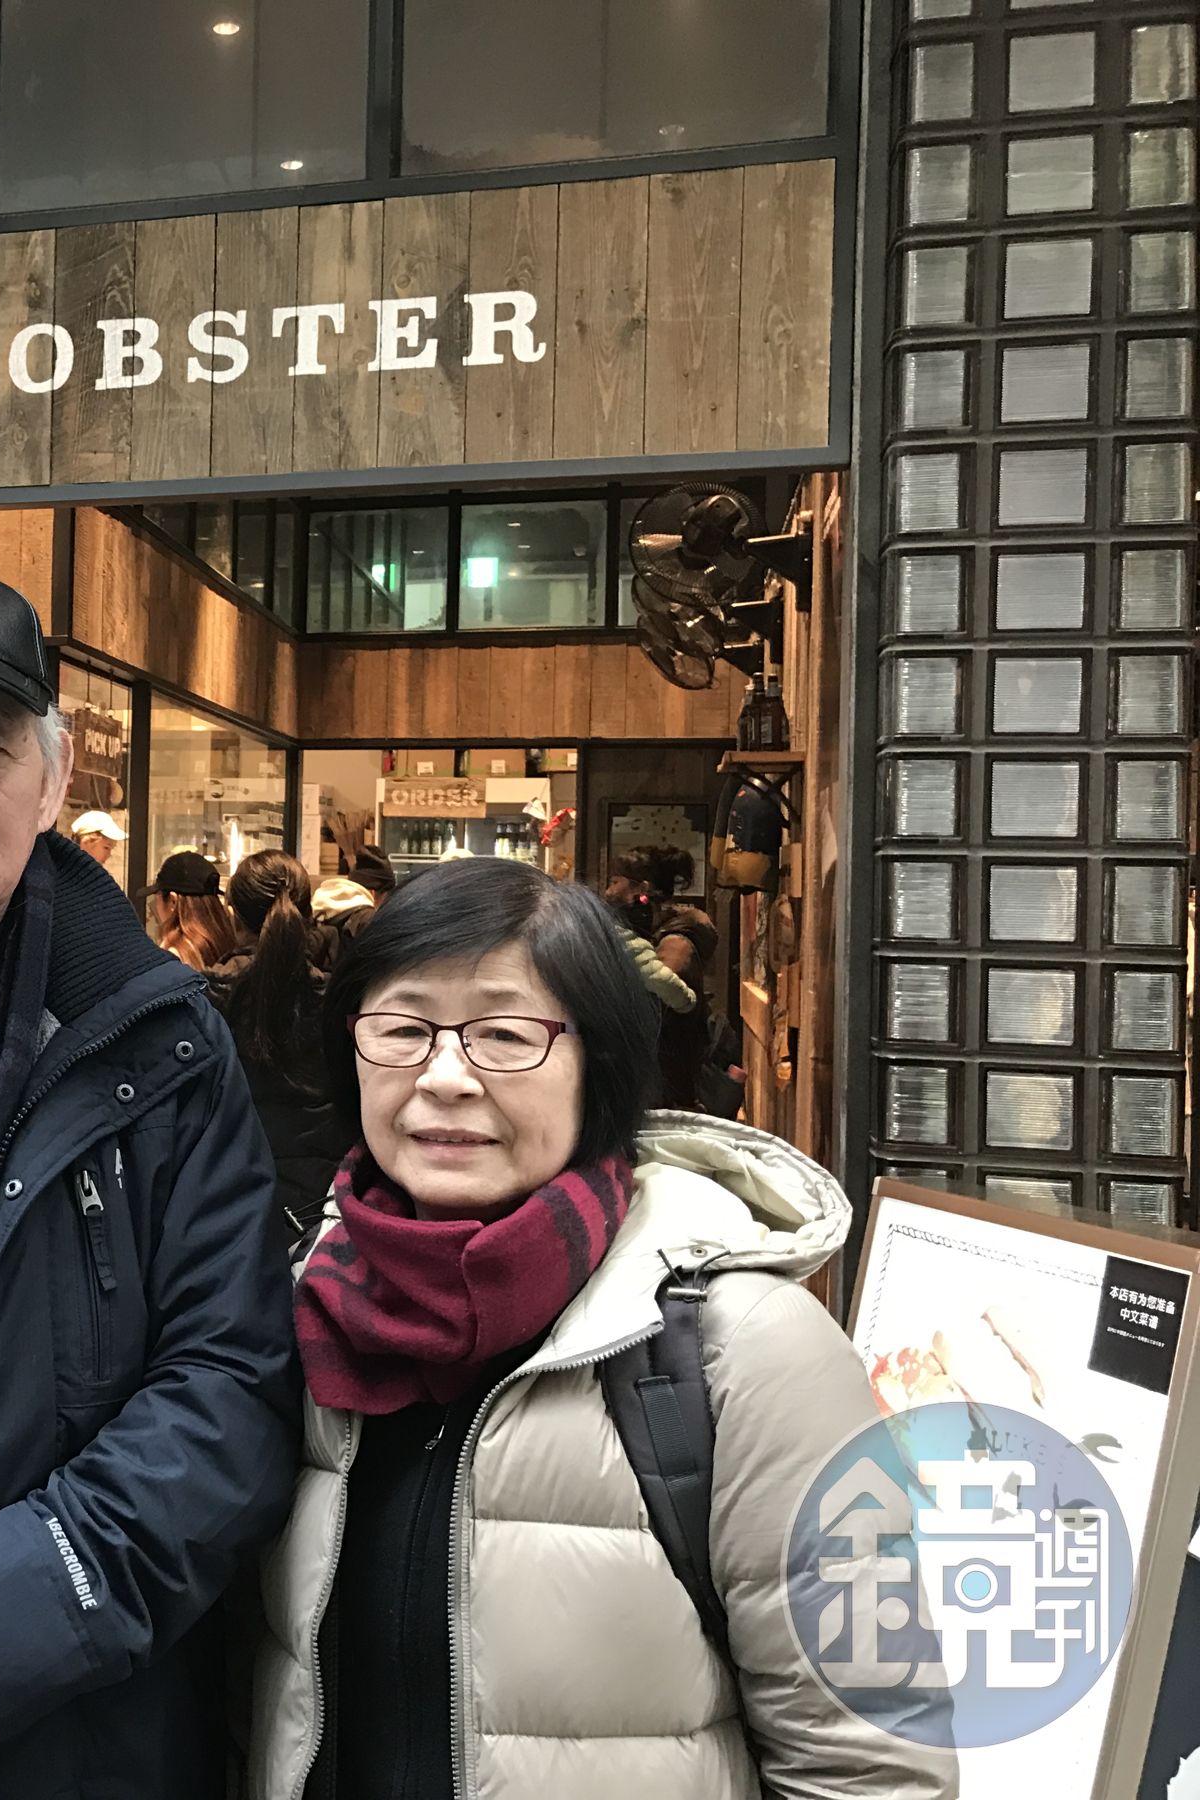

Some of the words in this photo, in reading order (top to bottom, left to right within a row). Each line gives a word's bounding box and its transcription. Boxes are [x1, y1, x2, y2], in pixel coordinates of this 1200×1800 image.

[84, 728, 107, 757] PICK
[108, 736, 121, 759] UP
[390, 787, 480, 808] ORDER
[1109, 1285, 1176, 1315] 本店有为您准备
[1119, 1307, 1159, 1330] 中文菜谱
